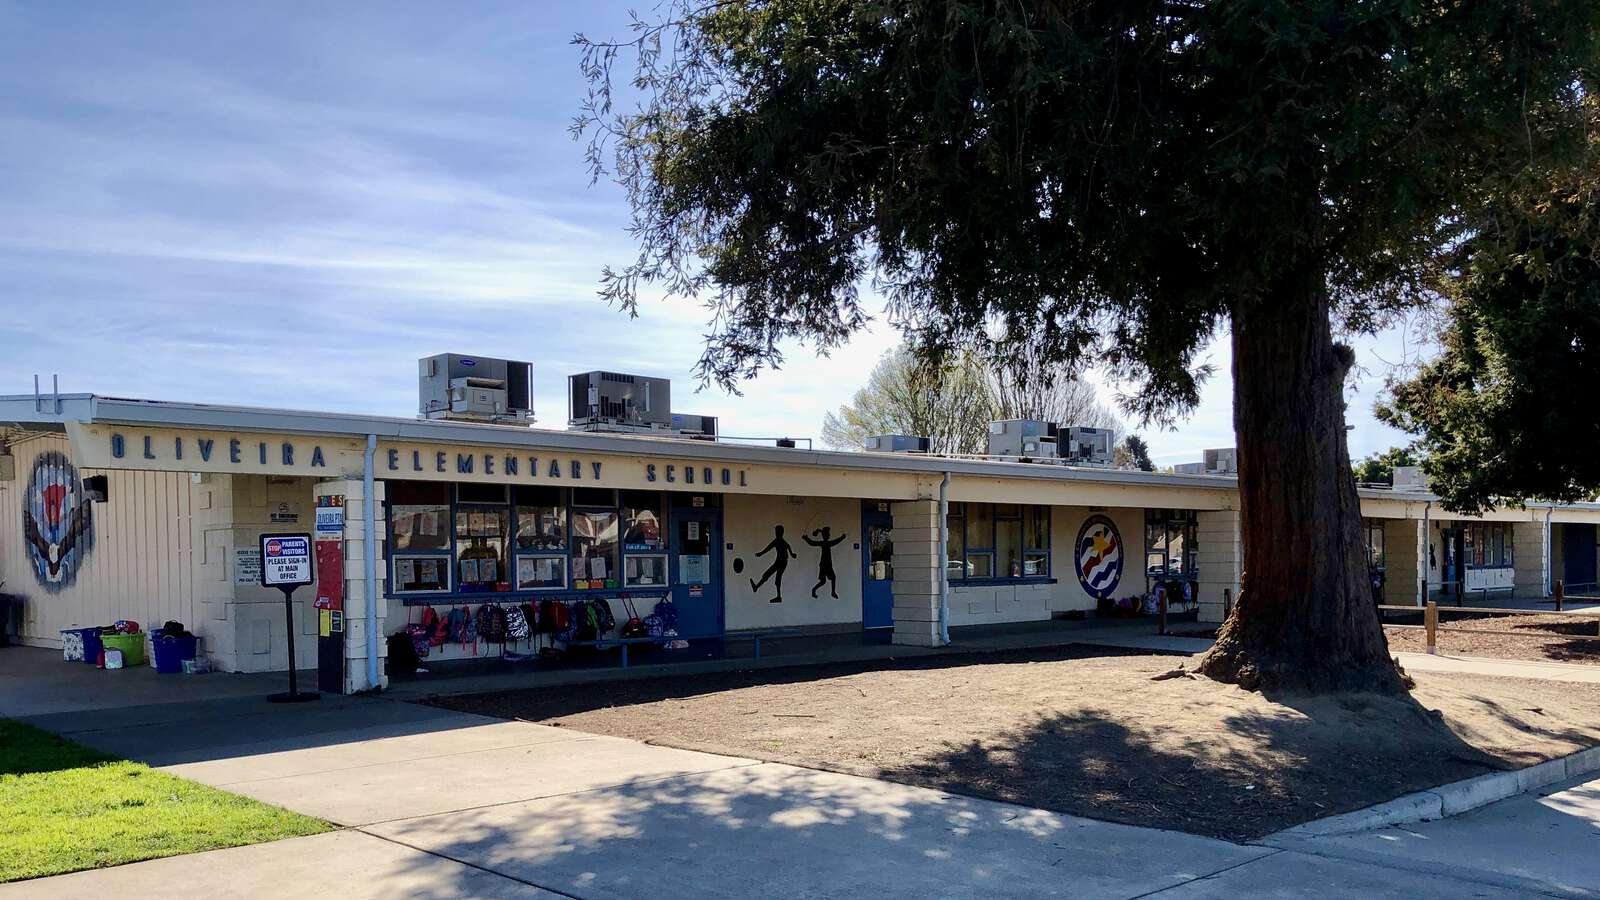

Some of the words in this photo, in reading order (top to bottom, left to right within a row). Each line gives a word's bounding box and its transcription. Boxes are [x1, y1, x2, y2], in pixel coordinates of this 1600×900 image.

[111, 433, 326, 467] OLIVEIRA
[388, 448, 602, 481] ELEMENTARY
[647, 463, 748, 487] SCHOOL
